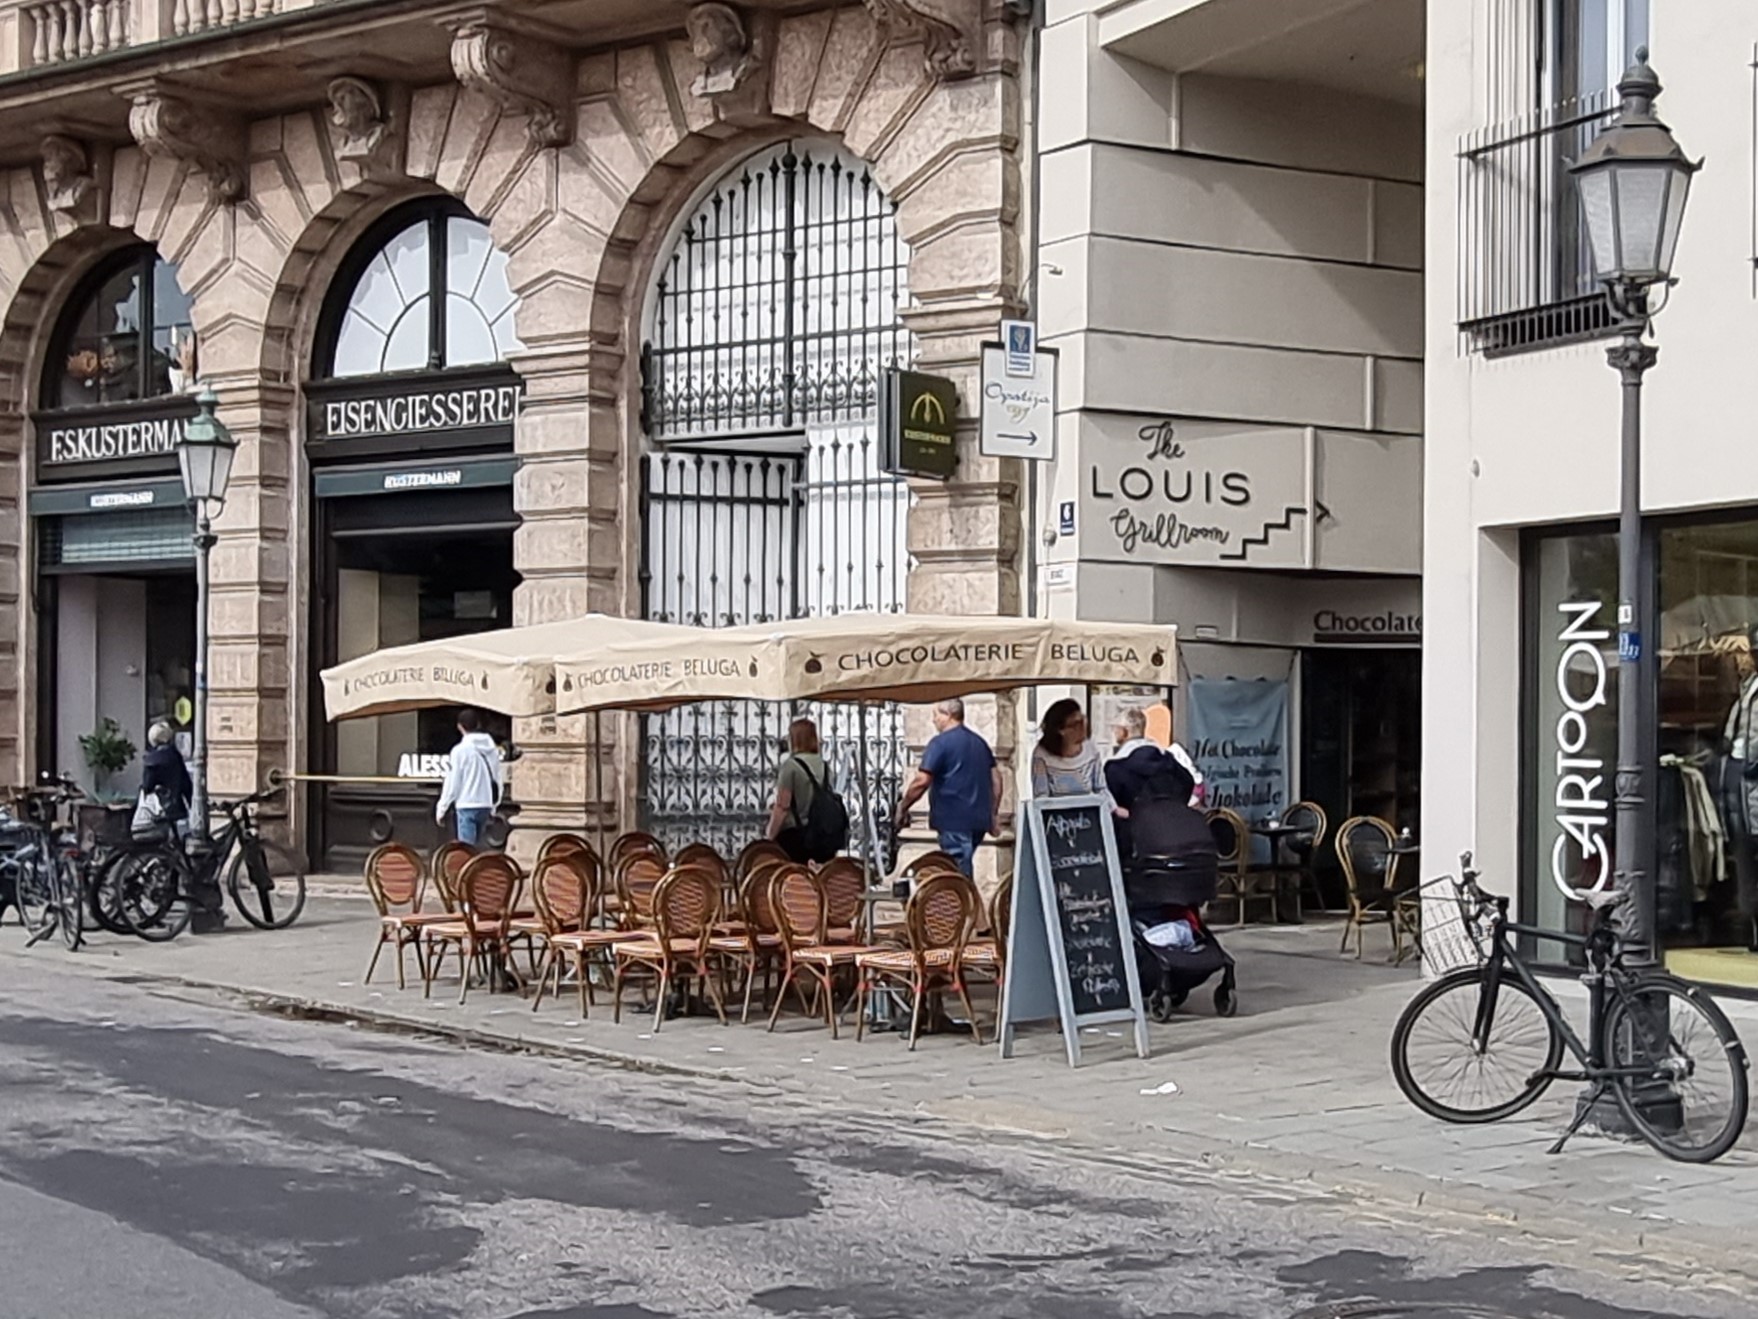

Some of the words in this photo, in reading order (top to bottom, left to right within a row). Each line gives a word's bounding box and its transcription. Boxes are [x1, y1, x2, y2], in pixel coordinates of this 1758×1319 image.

[326, 386, 521, 435] EISENGIESSEREI
[1139, 421, 1185, 460] The
[1092, 465, 1251, 506] LOUIS
[1110, 507, 1230, 553] Grillroom
[577, 661, 672, 688] CHOCOLATERIE
[684, 658, 741, 677] BELUGA
[838, 643, 1024, 672] CHOCOLATERIE
[1050, 643, 1140, 664] BELUGA
[1552, 600, 1610, 901] CARTOON
